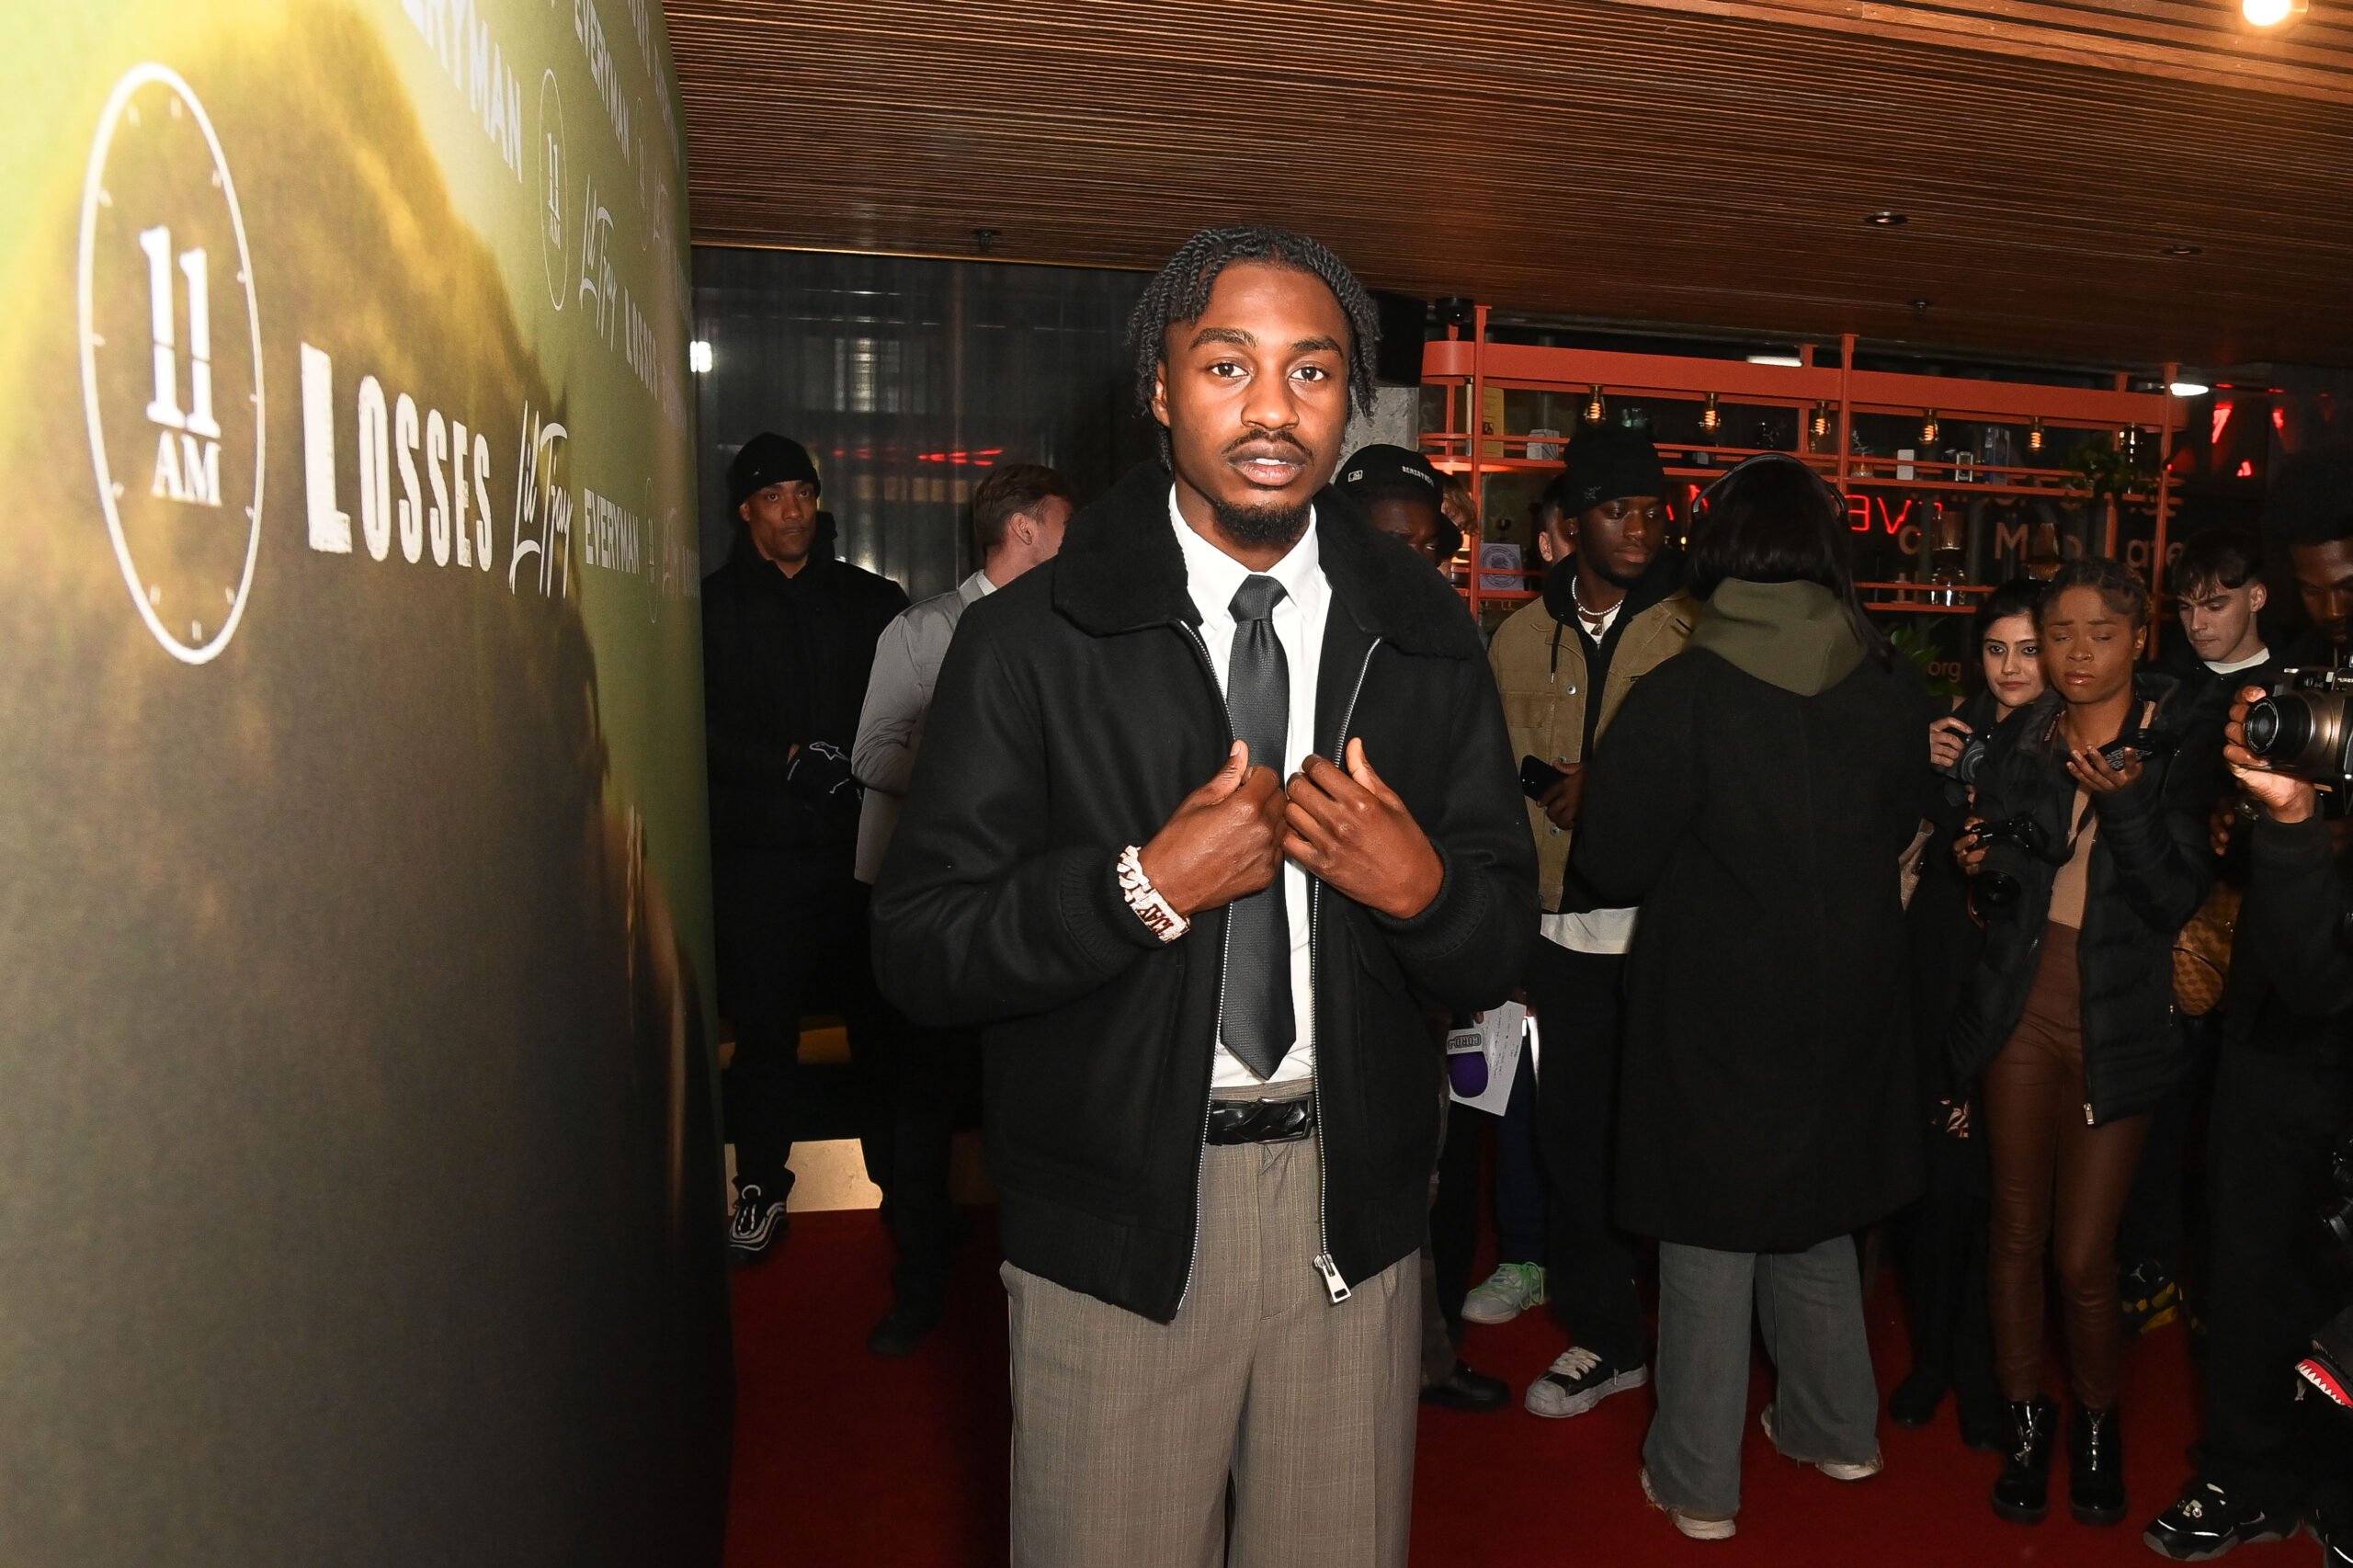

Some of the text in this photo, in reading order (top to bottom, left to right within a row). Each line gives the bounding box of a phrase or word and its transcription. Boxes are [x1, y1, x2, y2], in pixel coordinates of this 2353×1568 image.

[139, 225, 221, 438] 11
[151, 430, 222, 506] AM
[301, 341, 494, 573] LOSSES
[508, 399, 541, 596] Lil
[584, 487, 640, 575] EVERYMAN
